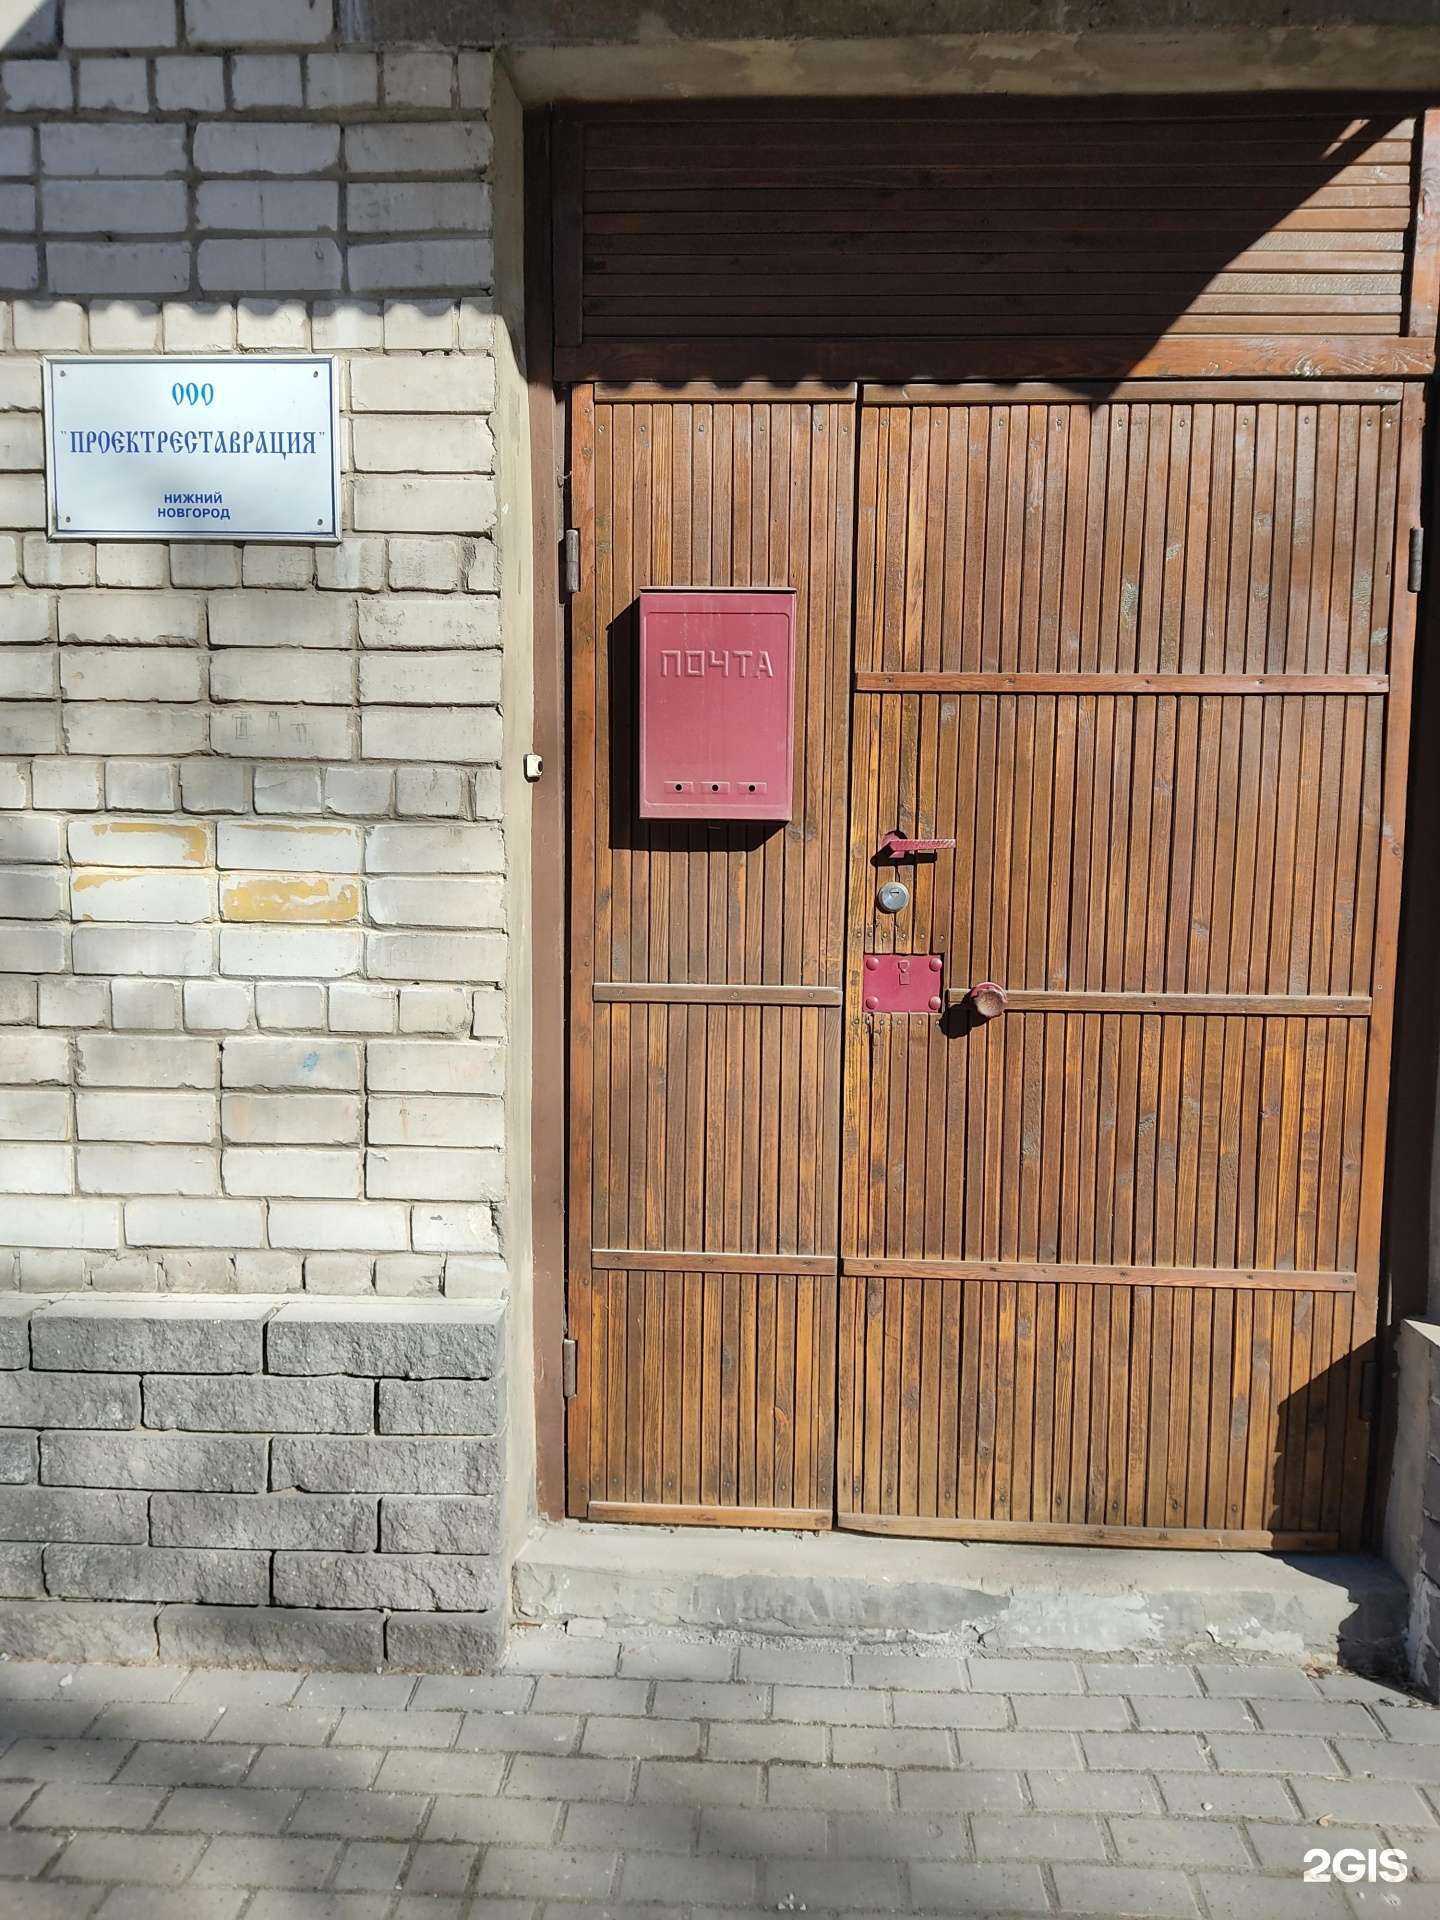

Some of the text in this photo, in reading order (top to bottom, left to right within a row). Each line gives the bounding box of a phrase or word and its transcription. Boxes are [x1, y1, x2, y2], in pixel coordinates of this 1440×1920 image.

[172, 382, 214, 406] ООО
[164, 491, 223, 504] НИЖНИЙ
[157, 507, 231, 520] НОВГОРОД
[661, 650, 774, 678] ПОЧТА
